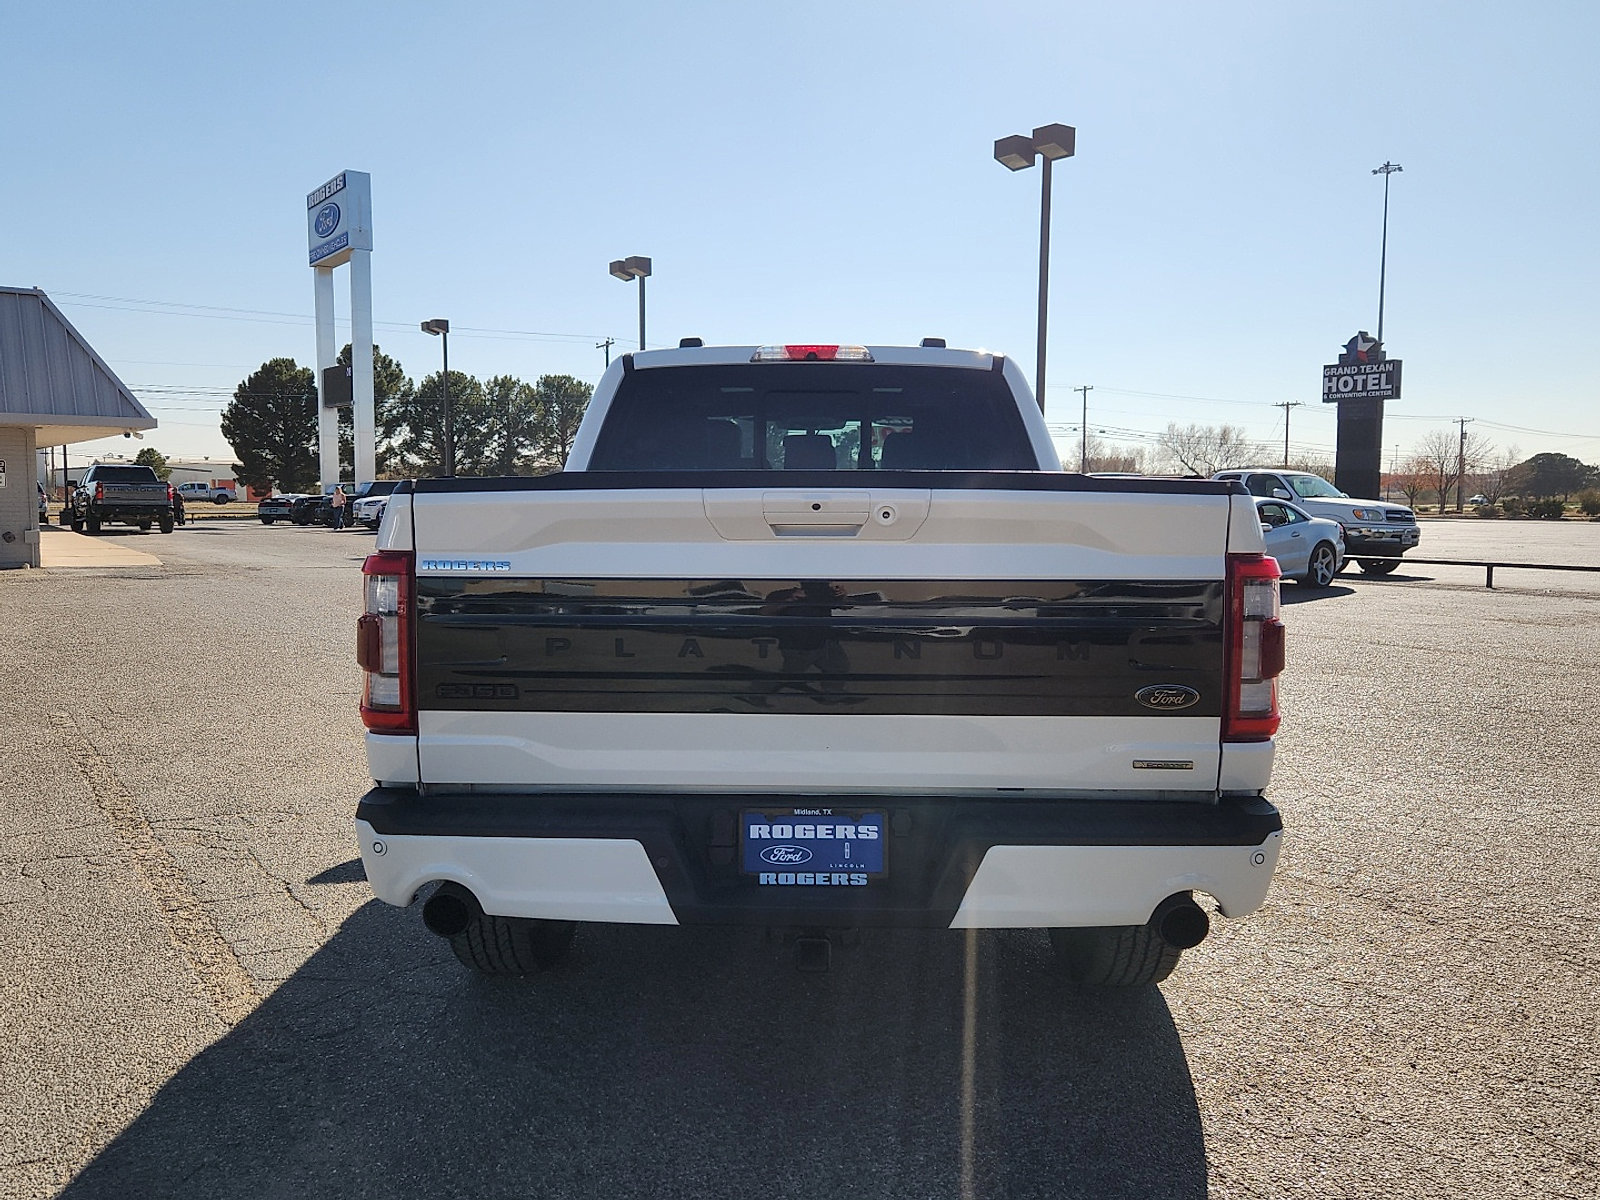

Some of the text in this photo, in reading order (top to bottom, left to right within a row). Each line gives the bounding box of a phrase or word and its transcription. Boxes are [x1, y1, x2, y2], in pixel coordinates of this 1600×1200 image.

[308, 176, 343, 208] ROGERS
[1325, 363, 1393, 376] GRAND TEXAN
[1323, 373, 1392, 393] HOTEL
[1329, 391, 1367, 399] CONVENTION
[421, 560, 512, 571] ROGERS
[544, 637, 1090, 661] PLATNUM
[1149, 689, 1186, 704] Ford
[793, 808, 833, 816] Midland, TX
[749, 824, 879, 840] ROGERS
[769, 847, 803, 862] Ford
[759, 872, 868, 886] ROGERS
